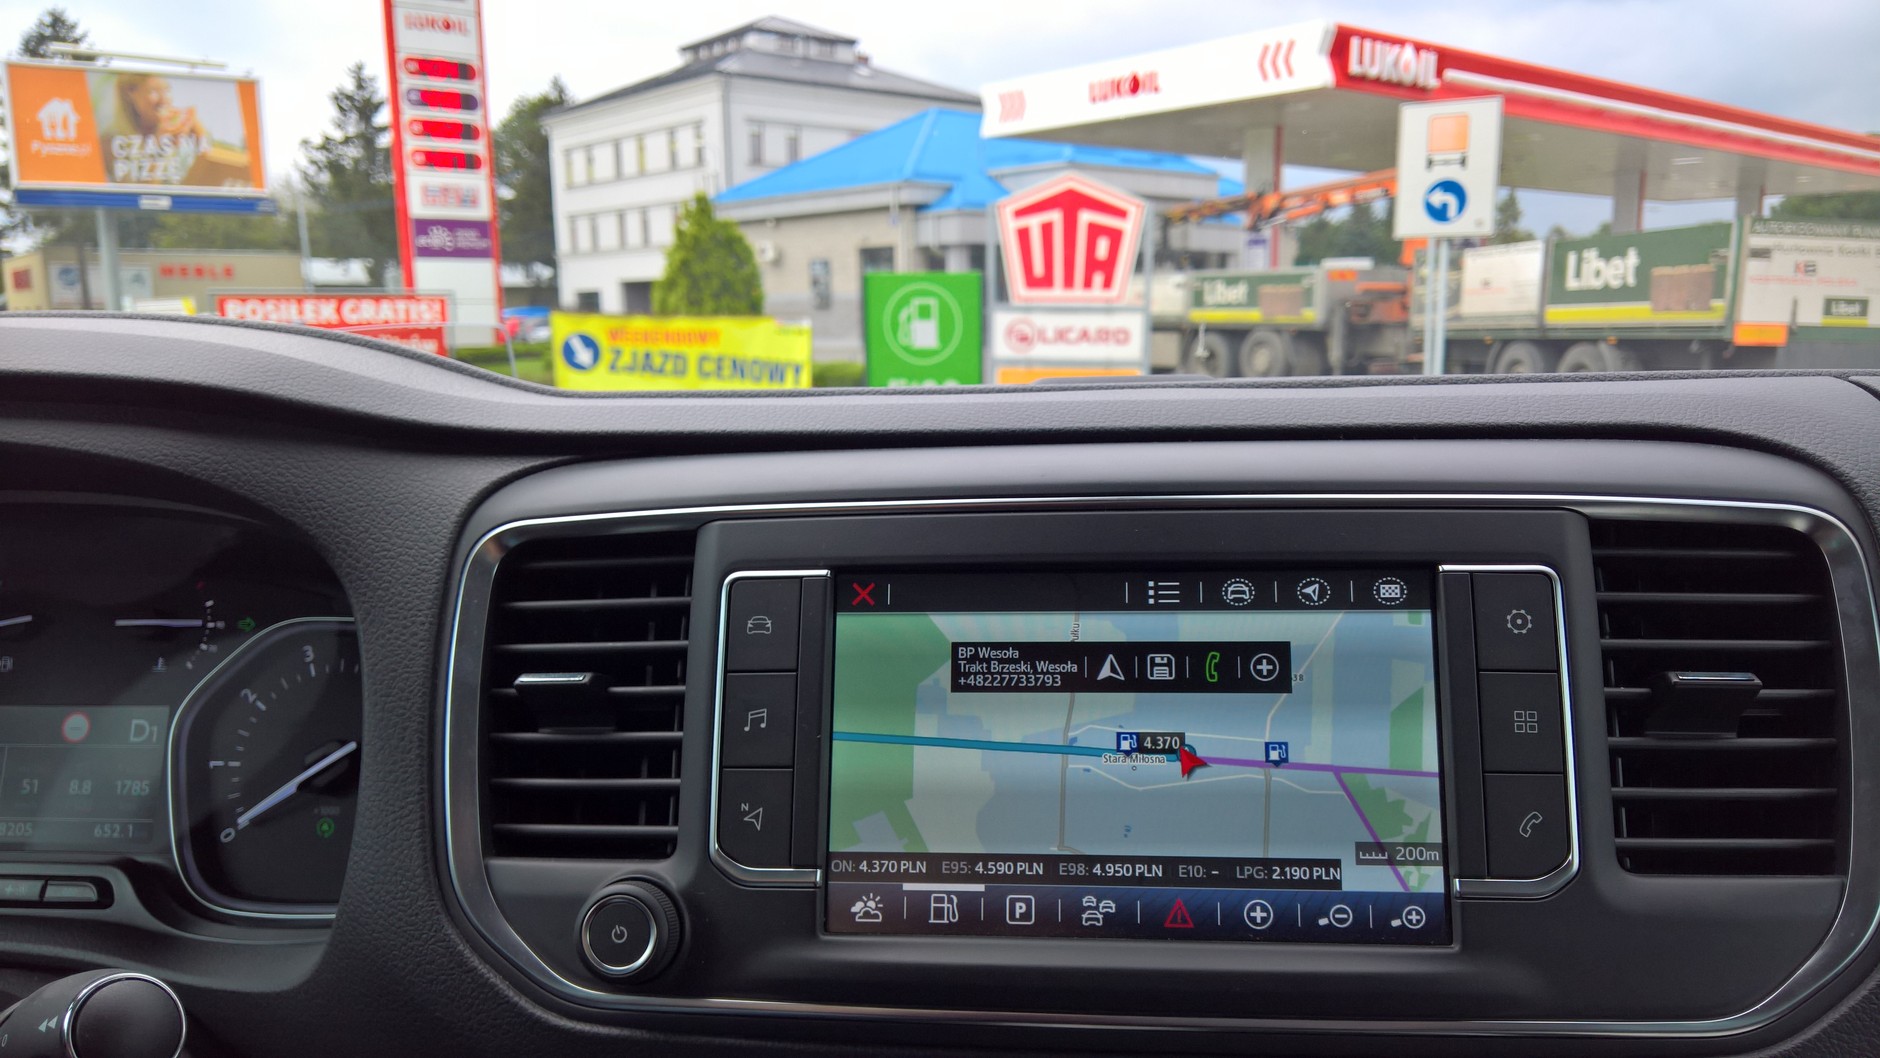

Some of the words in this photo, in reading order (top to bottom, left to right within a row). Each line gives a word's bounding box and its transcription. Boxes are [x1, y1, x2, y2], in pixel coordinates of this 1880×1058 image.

[1349, 35, 1440, 90] LUKOIL
[1088, 71, 1162, 103] LUKOIL
[111, 134, 174, 158] CZAS
[1014, 188, 1128, 289] UTA
[1565, 247, 1641, 291] Libet
[1203, 279, 1249, 306] Libet
[609, 349, 687, 377] ZJAZD
[698, 356, 803, 385] CENOWY
[302, 645, 314, 663] 3
[958, 647, 975, 659] BP
[978, 647, 1019, 659] Wesoła
[958, 661, 988, 673] Trakt
[990, 661, 1033, 674] Brzeski,
[1036, 661, 1078, 673] Wesoła
[958, 675, 1062, 687] +48227733793
[240, 688, 257, 704] 2
[1144, 736, 1180, 749] 4.370
[1104, 754, 1127, 764] Stara
[21, 779, 38, 795] 51
[70, 779, 92, 795] 8.8
[116, 780, 150, 795] 1785
[94, 823, 133, 838] 652.1
[220, 827, 236, 843] 0
[1395, 846, 1440, 862] 200m
[831, 860, 856, 872] ON:
[859, 860, 897, 873] 4.370
[900, 861, 927, 873] PLN
[942, 861, 972, 874] E95:
[975, 862, 1014, 875] 4.590
[1017, 862, 1044, 875] PLN
[1059, 863, 1089, 876] E98:
[1093, 863, 1132, 876] 4.950
[1135, 864, 1163, 877] PLN
[1178, 865, 1207, 878] E10:
[1236, 866, 1268, 879] LPG:
[1272, 867, 1309, 880] 2.190
[1313, 867, 1341, 880] PLN
